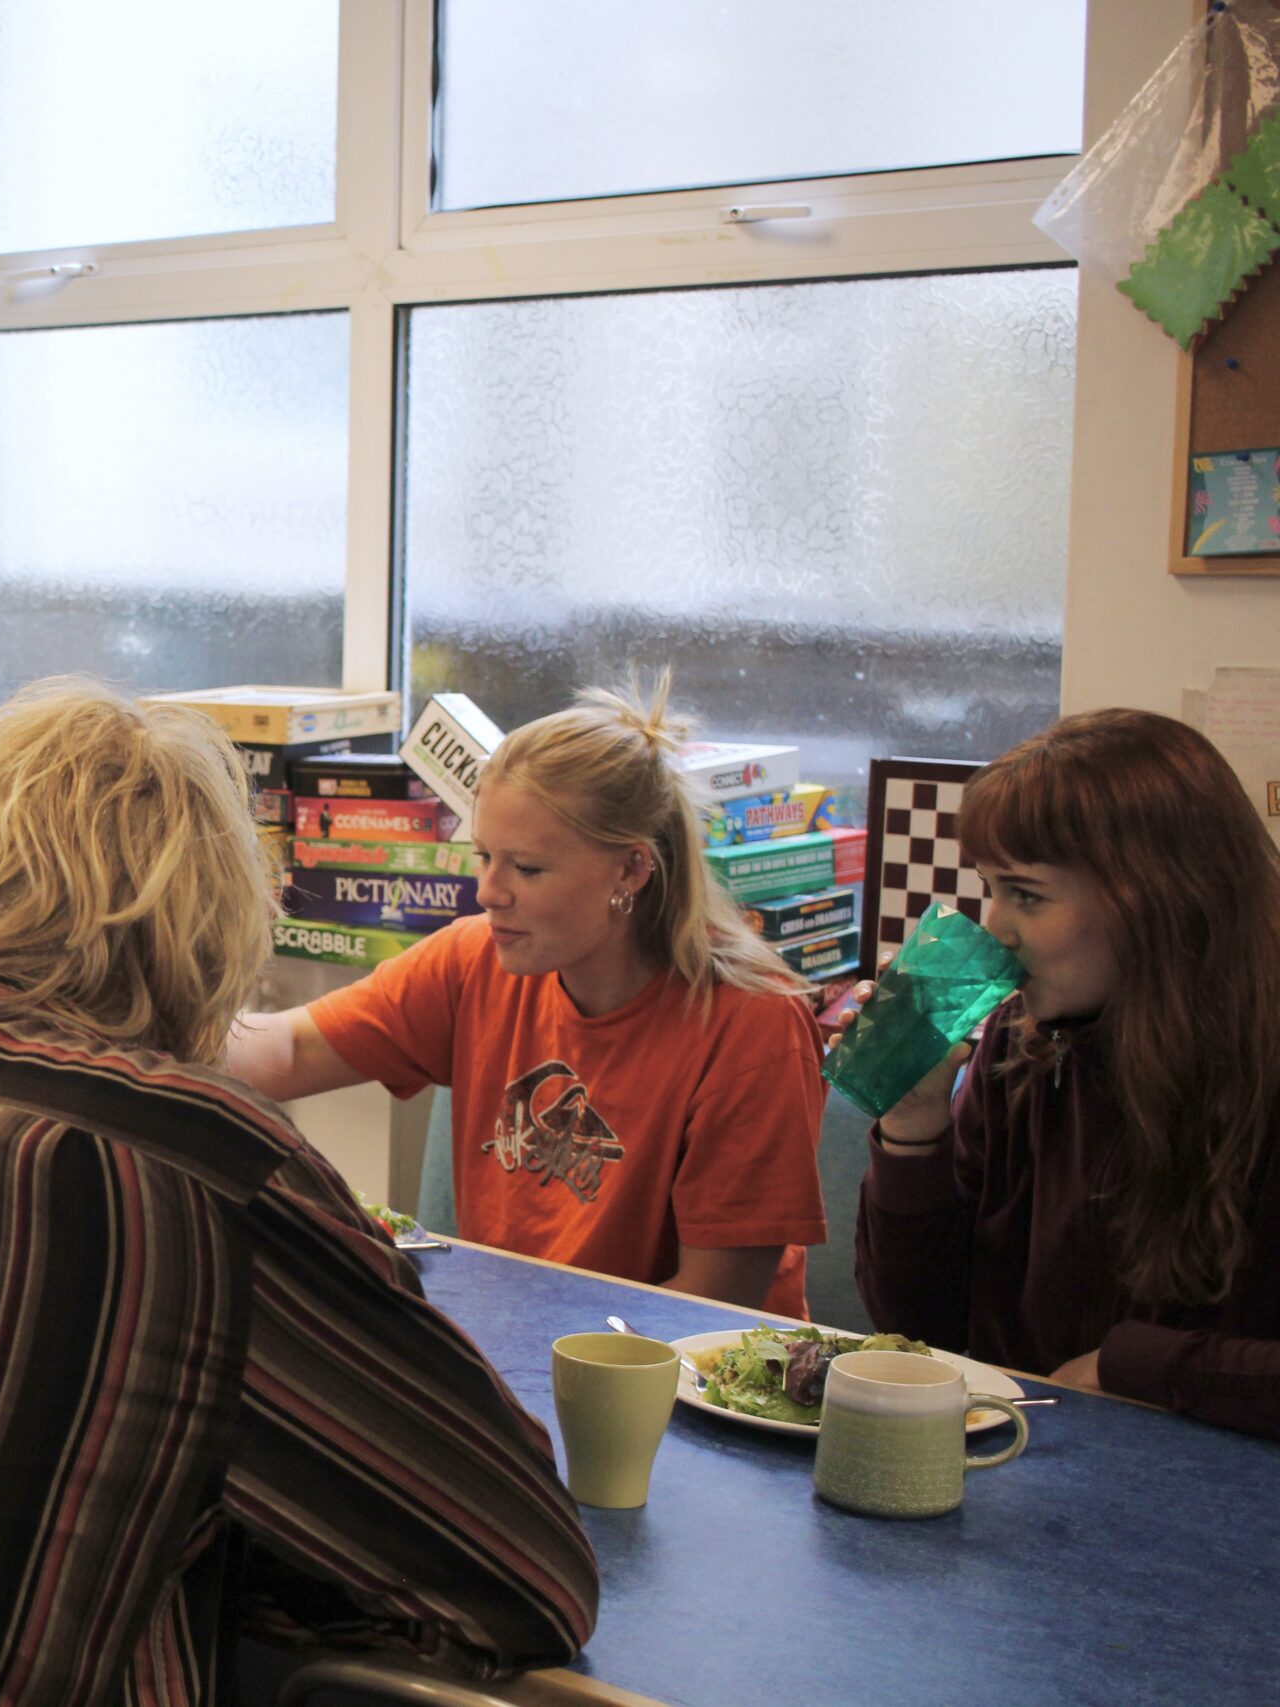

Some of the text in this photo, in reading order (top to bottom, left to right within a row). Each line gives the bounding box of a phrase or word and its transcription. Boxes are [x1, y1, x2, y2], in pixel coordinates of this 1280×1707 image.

[335, 813, 410, 832] CODENAMES
[746, 802, 804, 826] PATHWAYS
[335, 877, 462, 909] PICTIONARY
[273, 925, 366, 957] SCRABBLE
